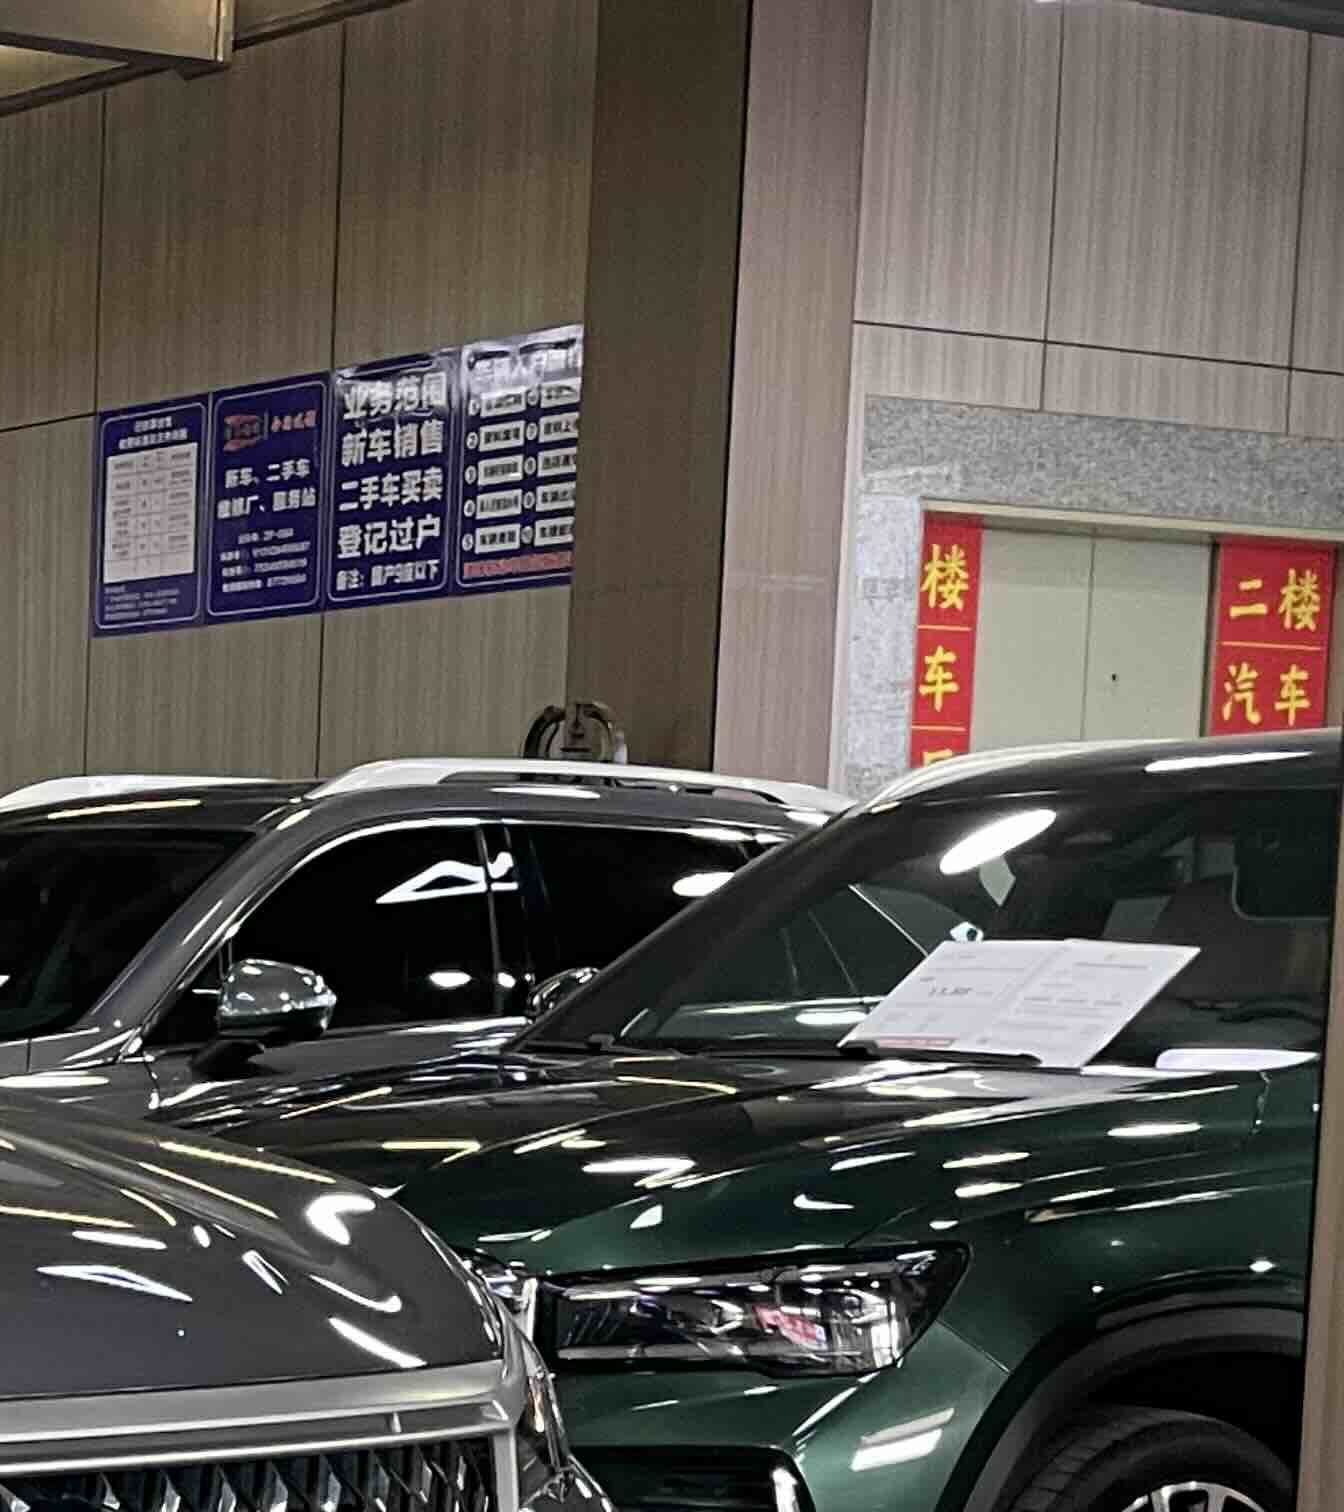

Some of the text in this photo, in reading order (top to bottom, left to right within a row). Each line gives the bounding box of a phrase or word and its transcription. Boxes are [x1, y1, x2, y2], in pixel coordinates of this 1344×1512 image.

[341, 420, 444, 467] 新车销售
[338, 467, 443, 511] 二手车买卖
[337, 516, 441, 560] 登记过户
[1228, 567, 1322, 632] 二楼
[1221, 662, 1311, 727] 汽车
